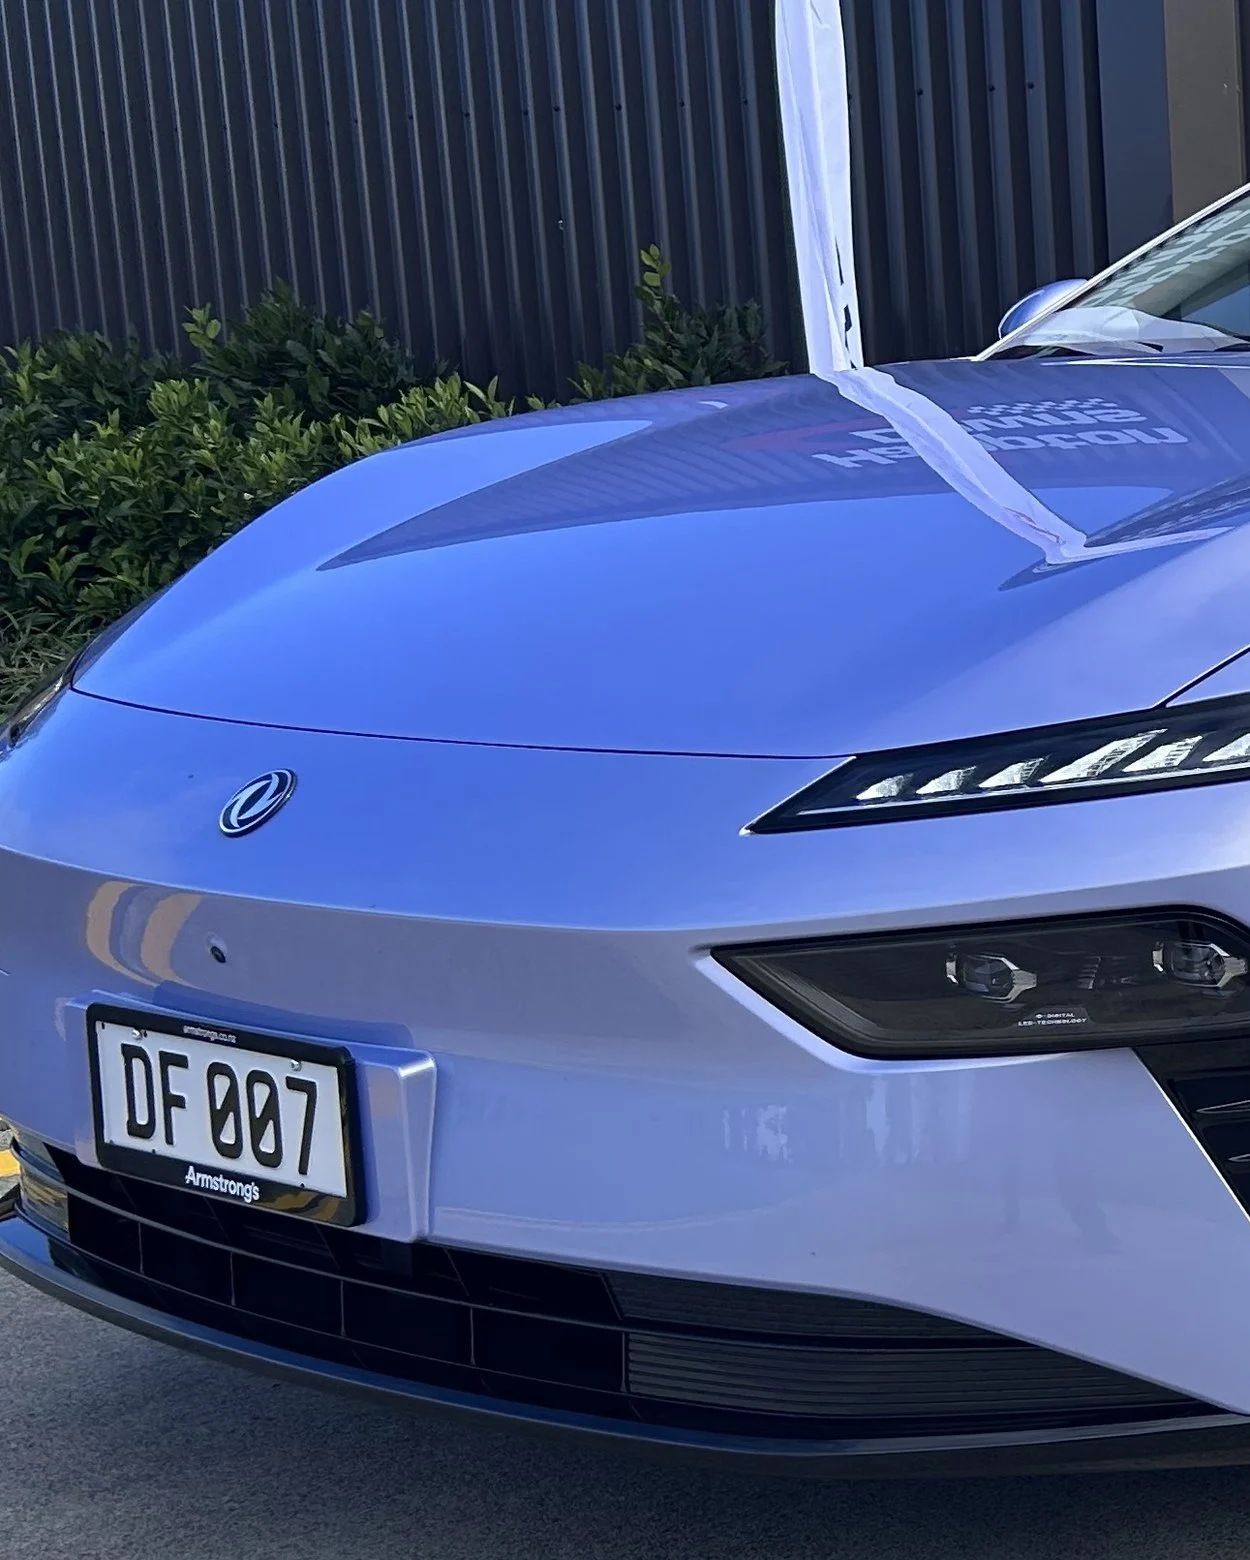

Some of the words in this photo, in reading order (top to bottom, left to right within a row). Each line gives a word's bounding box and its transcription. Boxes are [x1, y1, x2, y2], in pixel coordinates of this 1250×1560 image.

[120, 1042, 190, 1146] DF
[206, 1060, 318, 1176] 007
[184, 1164, 261, 1204] Armstrong's
